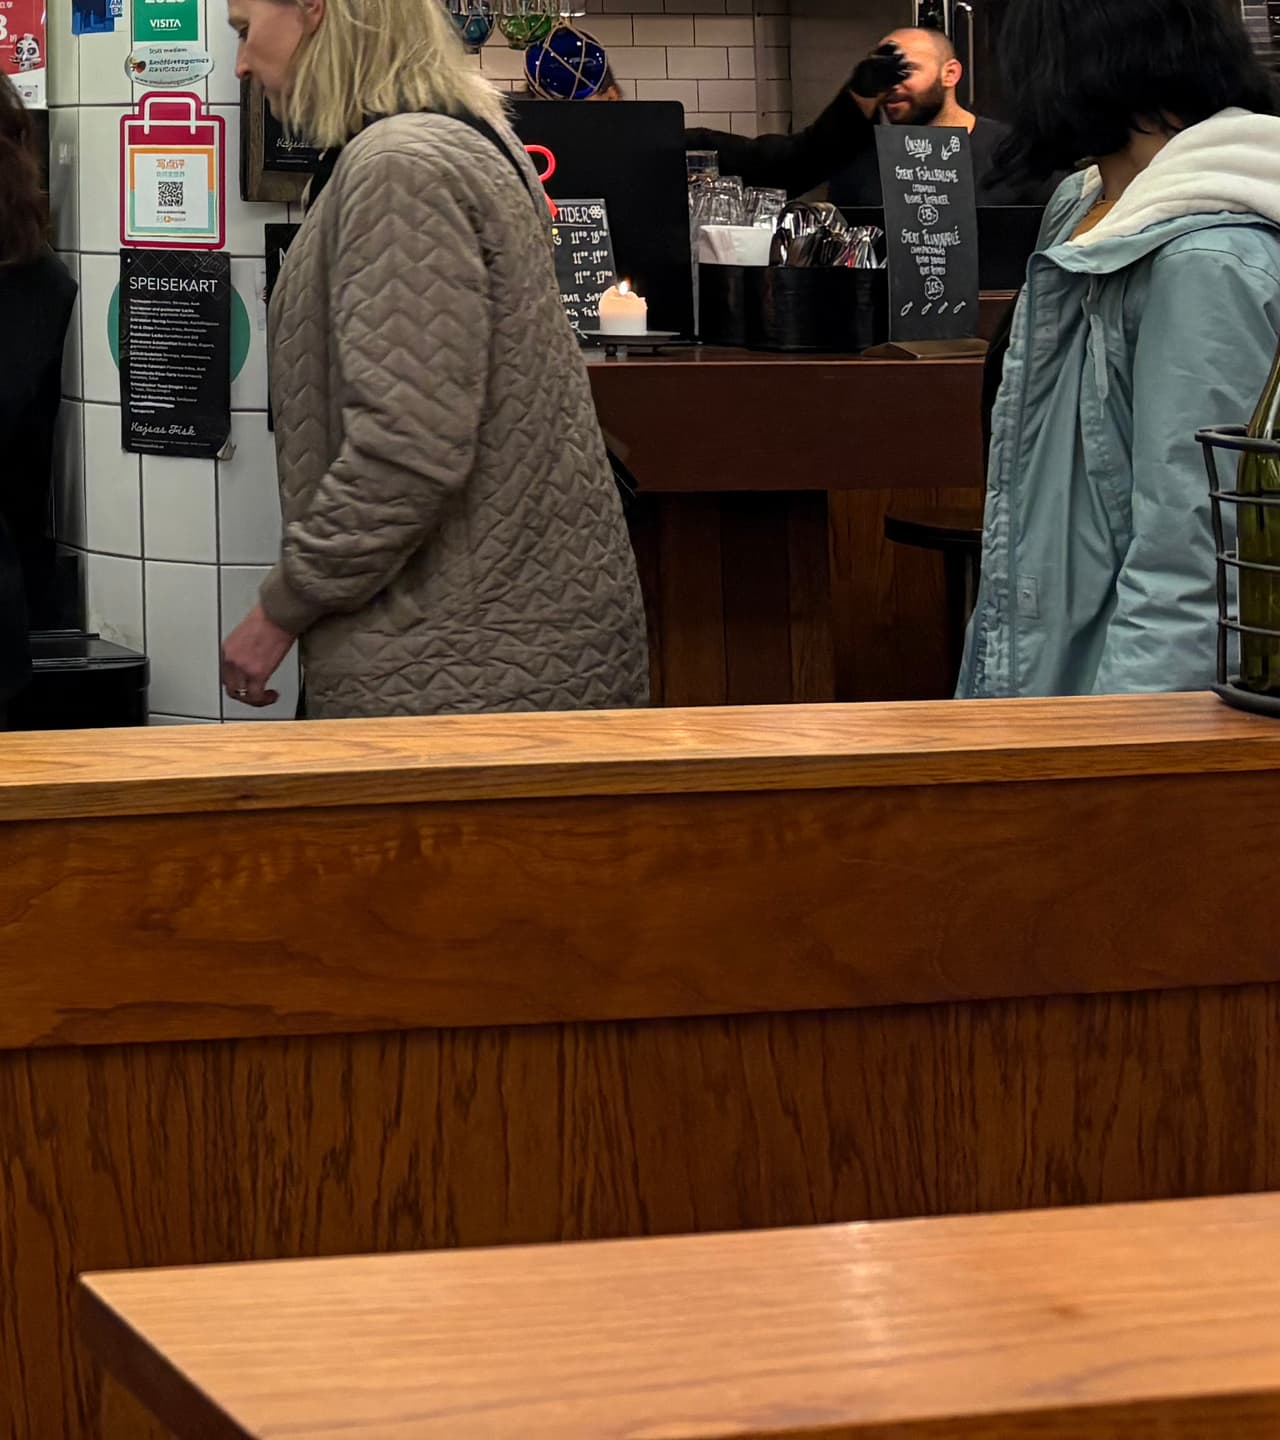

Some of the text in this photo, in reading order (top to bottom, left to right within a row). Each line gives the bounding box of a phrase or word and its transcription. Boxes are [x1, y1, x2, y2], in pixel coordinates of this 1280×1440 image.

[150, 19, 181, 28] VISITA
[129, 276, 218, 293] SPEISEKART
[131, 422, 196, 436] Kajsas Fisk
